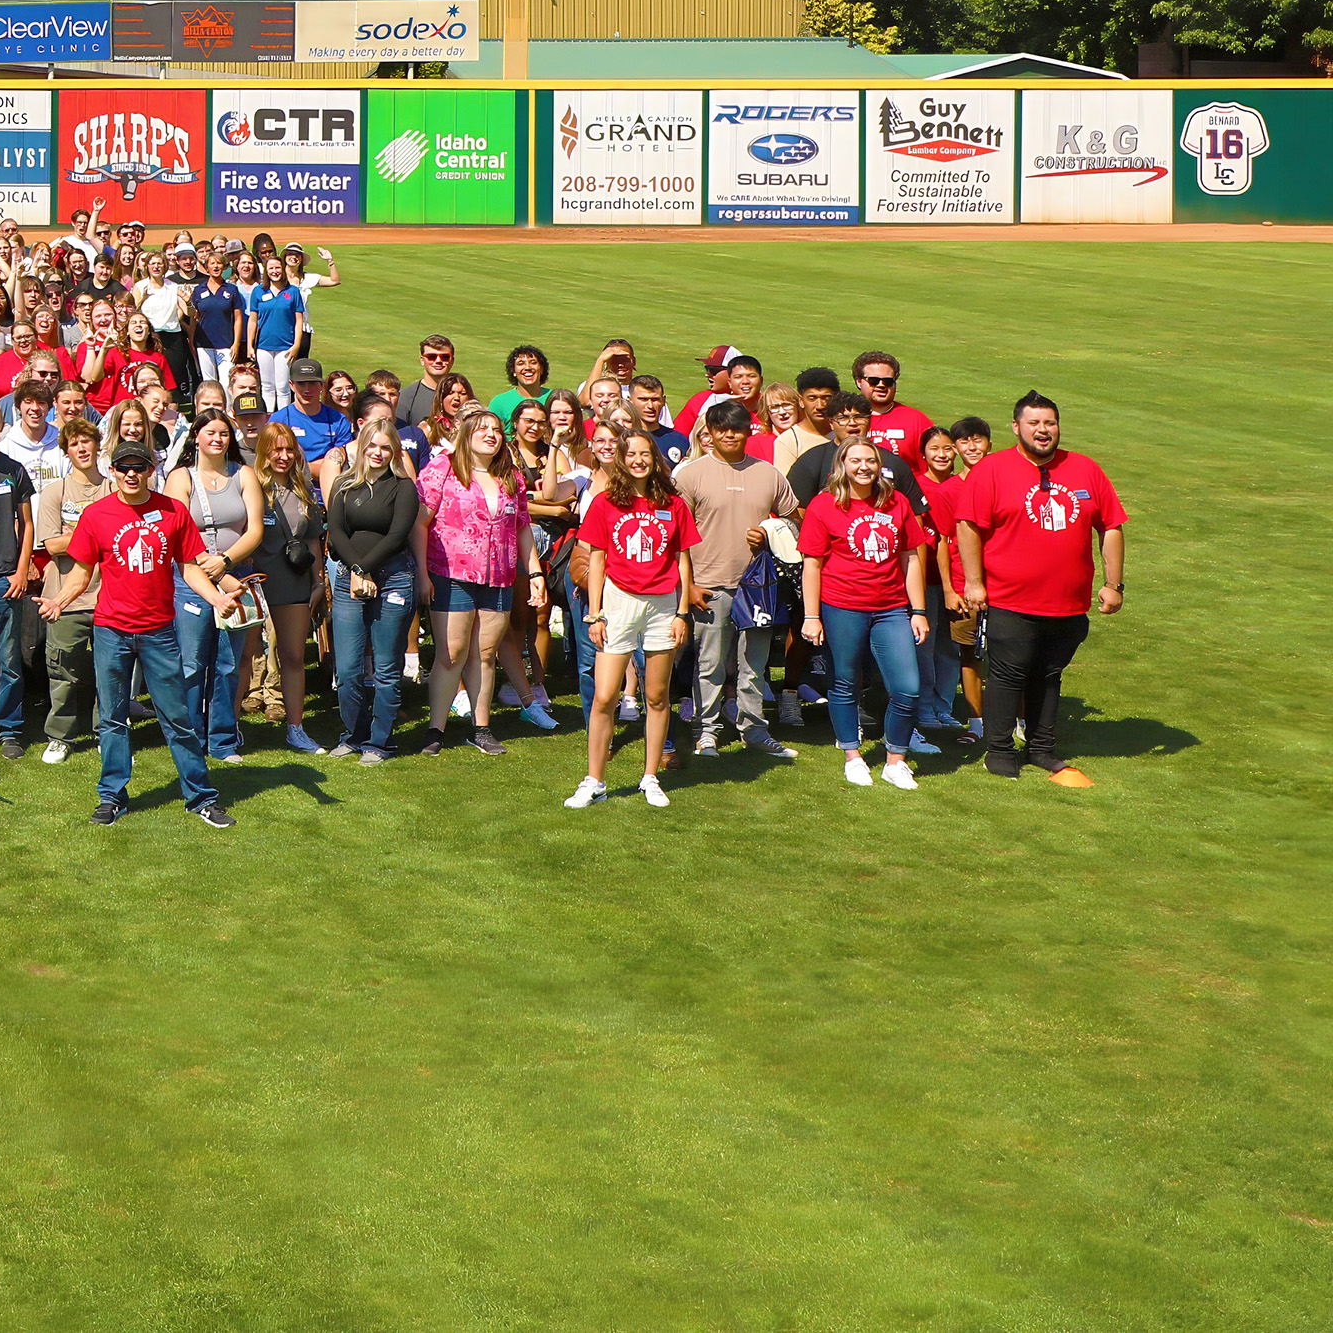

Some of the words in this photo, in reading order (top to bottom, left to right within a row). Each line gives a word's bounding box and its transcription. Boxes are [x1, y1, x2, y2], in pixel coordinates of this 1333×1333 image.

[355, 17, 467, 41] sodexo
[37, 42, 101, 54] CLINIC
[309, 46, 345, 59] Making
[349, 48, 376, 59] every
[380, 46, 399, 59] day
[401, 49, 408, 57] a
[412, 46, 443, 57] better
[447, 45, 465, 59] day
[712, 104, 857, 125] ROGERS
[919, 97, 967, 123] Guy
[253, 108, 356, 141] CTR
[585, 114, 696, 142] GRAND
[1208, 116, 1240, 126] BENARD
[883, 119, 1004, 148] Bennett
[1056, 125, 1083, 155] K
[1085, 130, 1107, 155] &
[1112, 124, 1139, 155] G
[74, 112, 191, 175] SHARP'S
[435, 133, 488, 151] Idaho
[607, 144, 674, 153] HOTEL
[1206, 129, 1244, 160] 16
[939, 145, 977, 156] Company
[434, 150, 506, 169] Central
[1033, 156, 1155, 169] CONSTRUCTION
[219, 170, 258, 191] Fire
[264, 170, 282, 190] &
[286, 170, 351, 191] Water
[435, 171, 470, 181] CREDIT
[474, 171, 505, 181] UNION
[737, 173, 829, 186] SUBARU
[890, 169, 970, 184] Committed
[973, 169, 991, 184] To
[561, 176, 695, 193] 208-799-1000
[898, 184, 983, 198] Sustainable
[225, 195, 345, 214] Restoration
[561, 197, 695, 212] hcgrandhotel.com
[752, 194, 775, 202] About
[776, 194, 795, 202] What
[718, 207, 849, 222] rogerssubaru.com
[876, 199, 938, 215] Forestry
[942, 199, 1003, 213] Initiative
